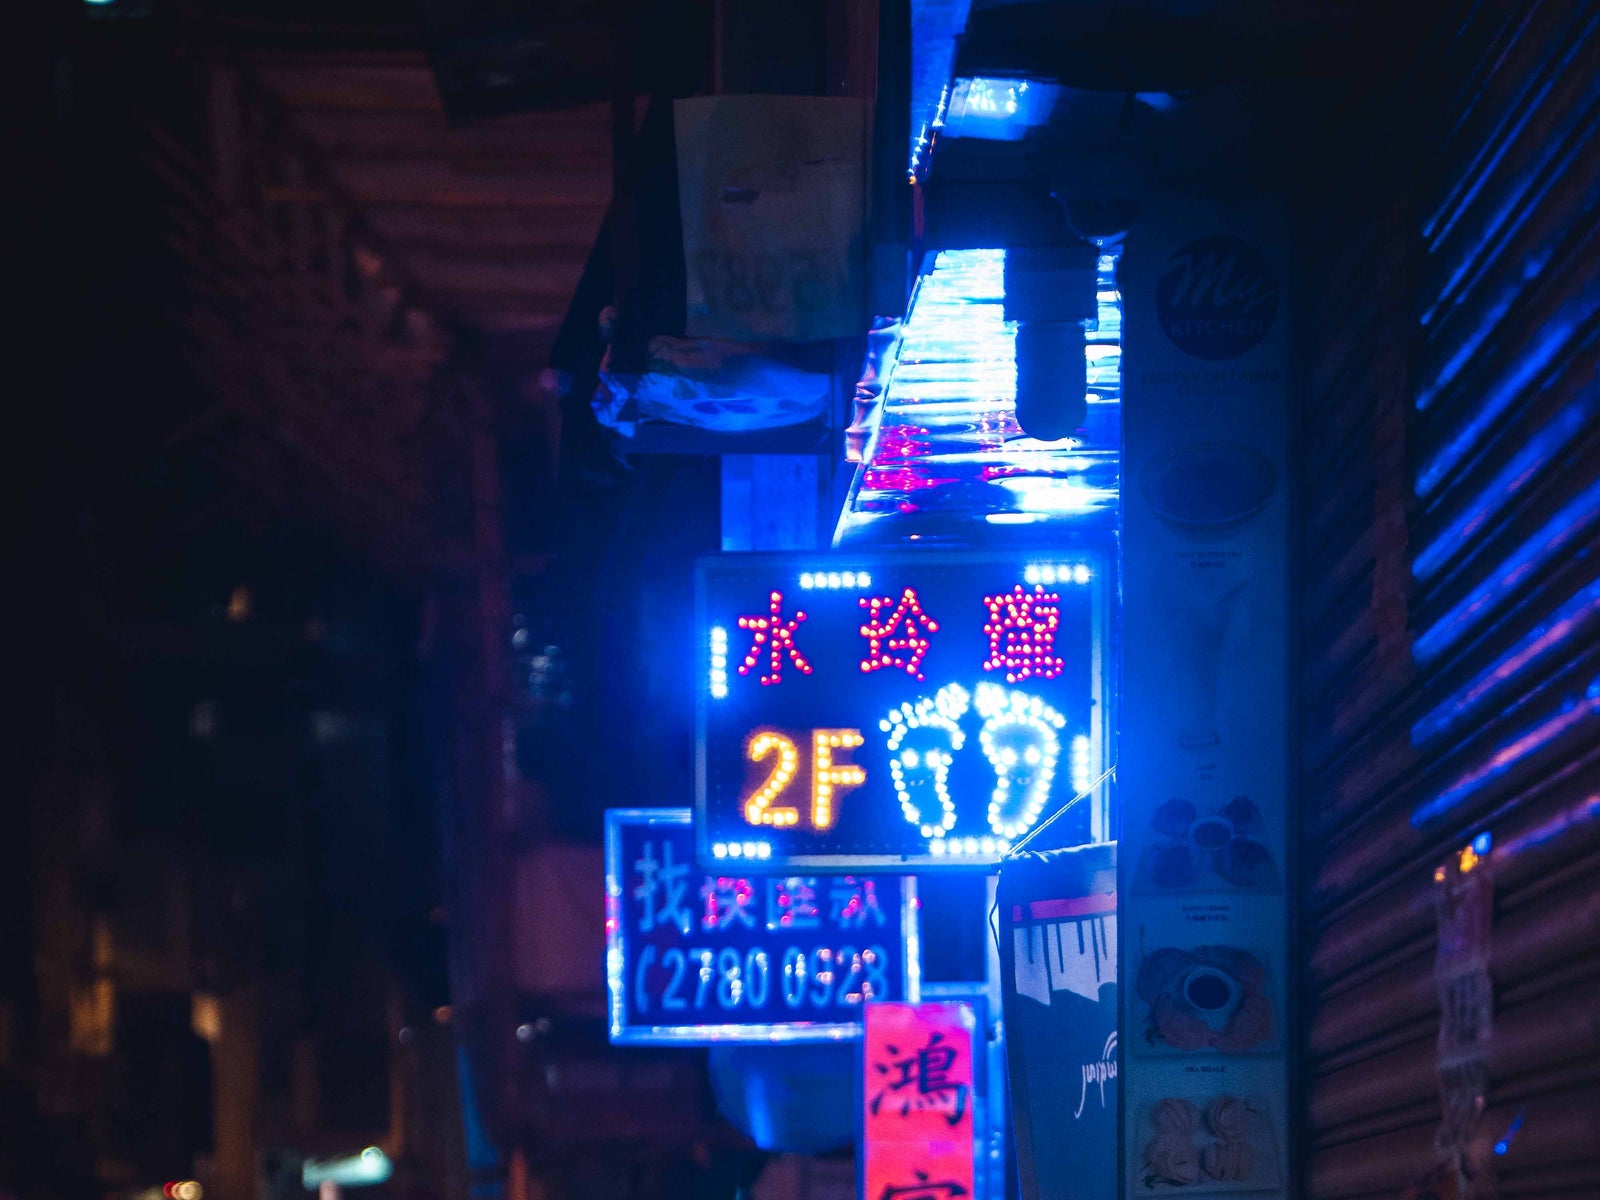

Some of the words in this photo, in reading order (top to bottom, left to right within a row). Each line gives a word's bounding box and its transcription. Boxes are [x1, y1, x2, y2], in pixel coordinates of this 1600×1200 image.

[1170, 318, 1265, 337] KITCHEN
[738, 584, 1064, 684] 水玲瓏
[744, 728, 867, 829] 2F
